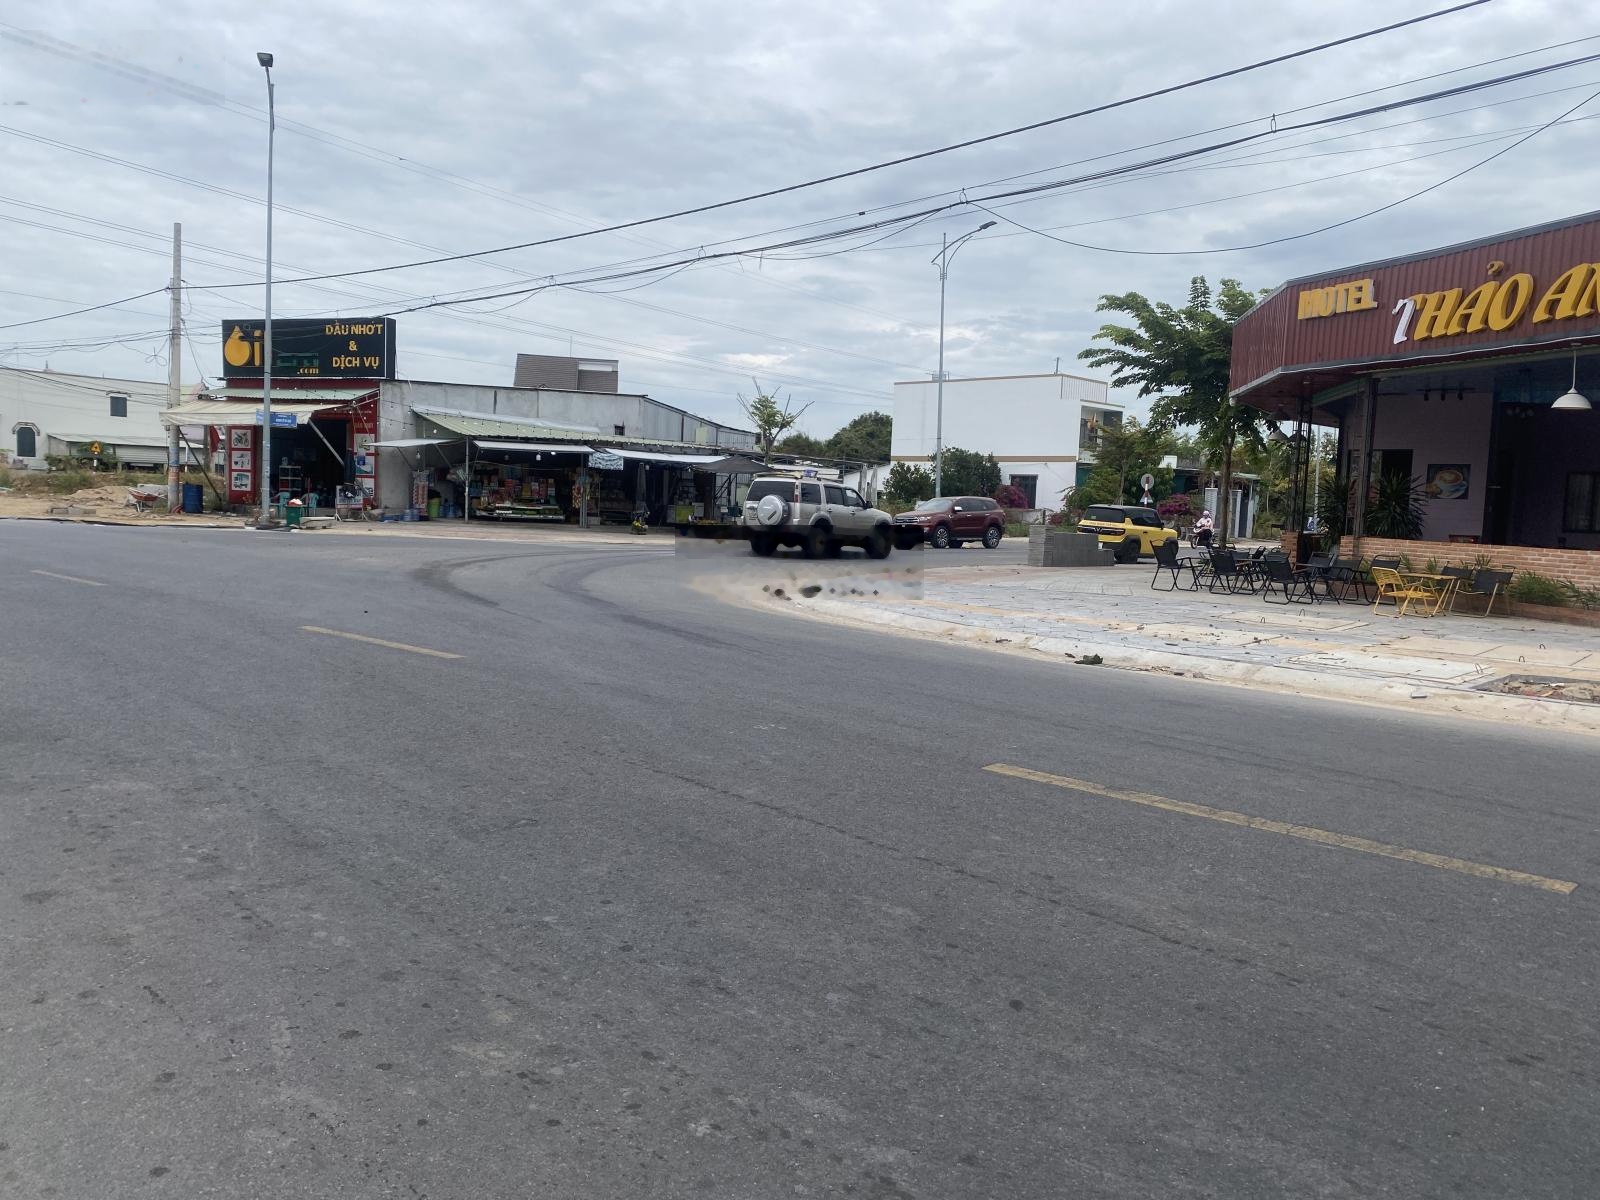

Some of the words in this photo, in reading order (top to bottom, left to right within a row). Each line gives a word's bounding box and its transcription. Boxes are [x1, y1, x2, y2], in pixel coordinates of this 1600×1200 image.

[1298, 279, 1378, 320] MOTEL
[1391, 261, 1534, 345] THẢO
[348, 340, 358, 351] &
[332, 355, 360, 370] DỊCH
[363, 356, 380, 370] VỤ
